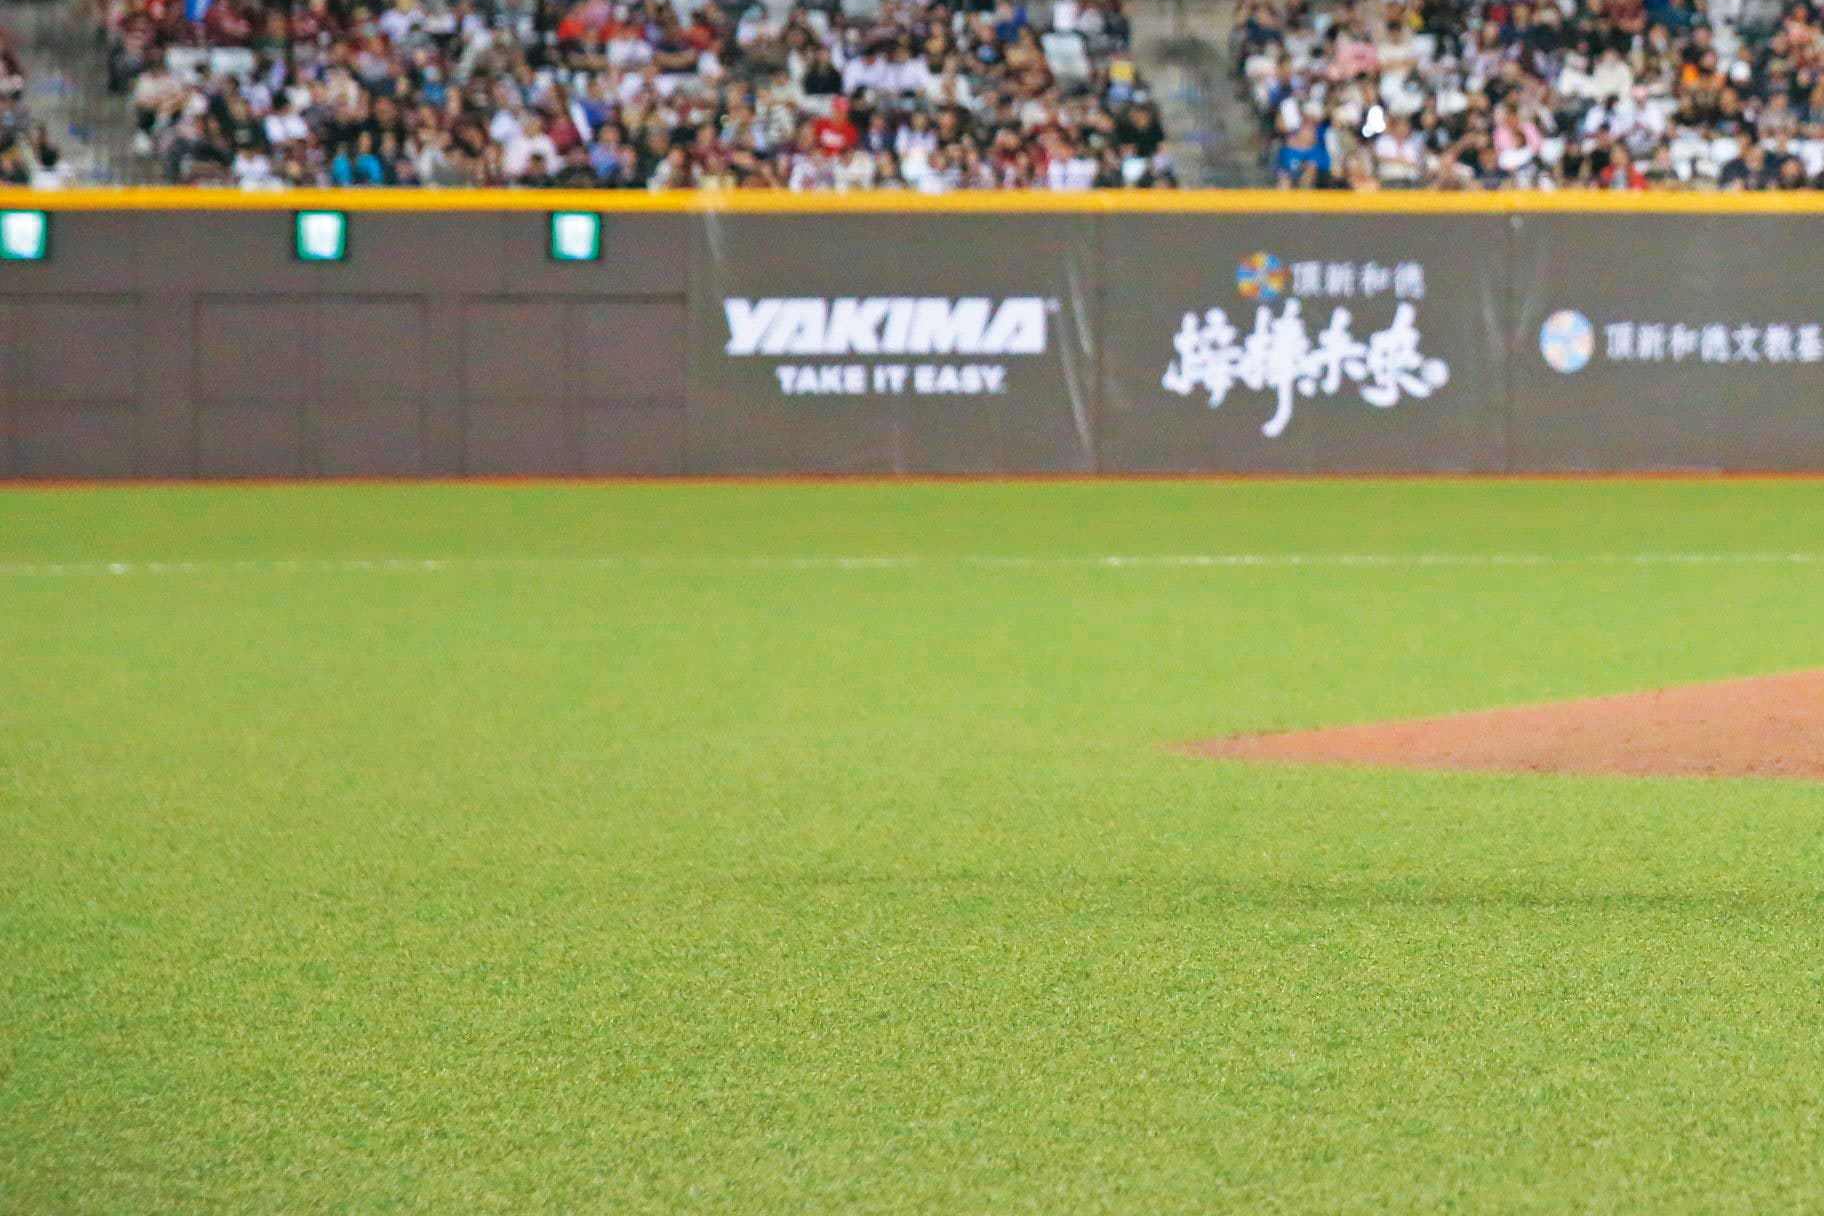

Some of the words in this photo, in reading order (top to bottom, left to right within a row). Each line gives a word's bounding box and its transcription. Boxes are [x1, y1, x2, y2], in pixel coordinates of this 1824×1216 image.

[723, 296, 1049, 355] YAKIMA
[775, 364, 867, 396] TAKE
[872, 364, 909, 396] IT
[913, 364, 1008, 396] EASY
